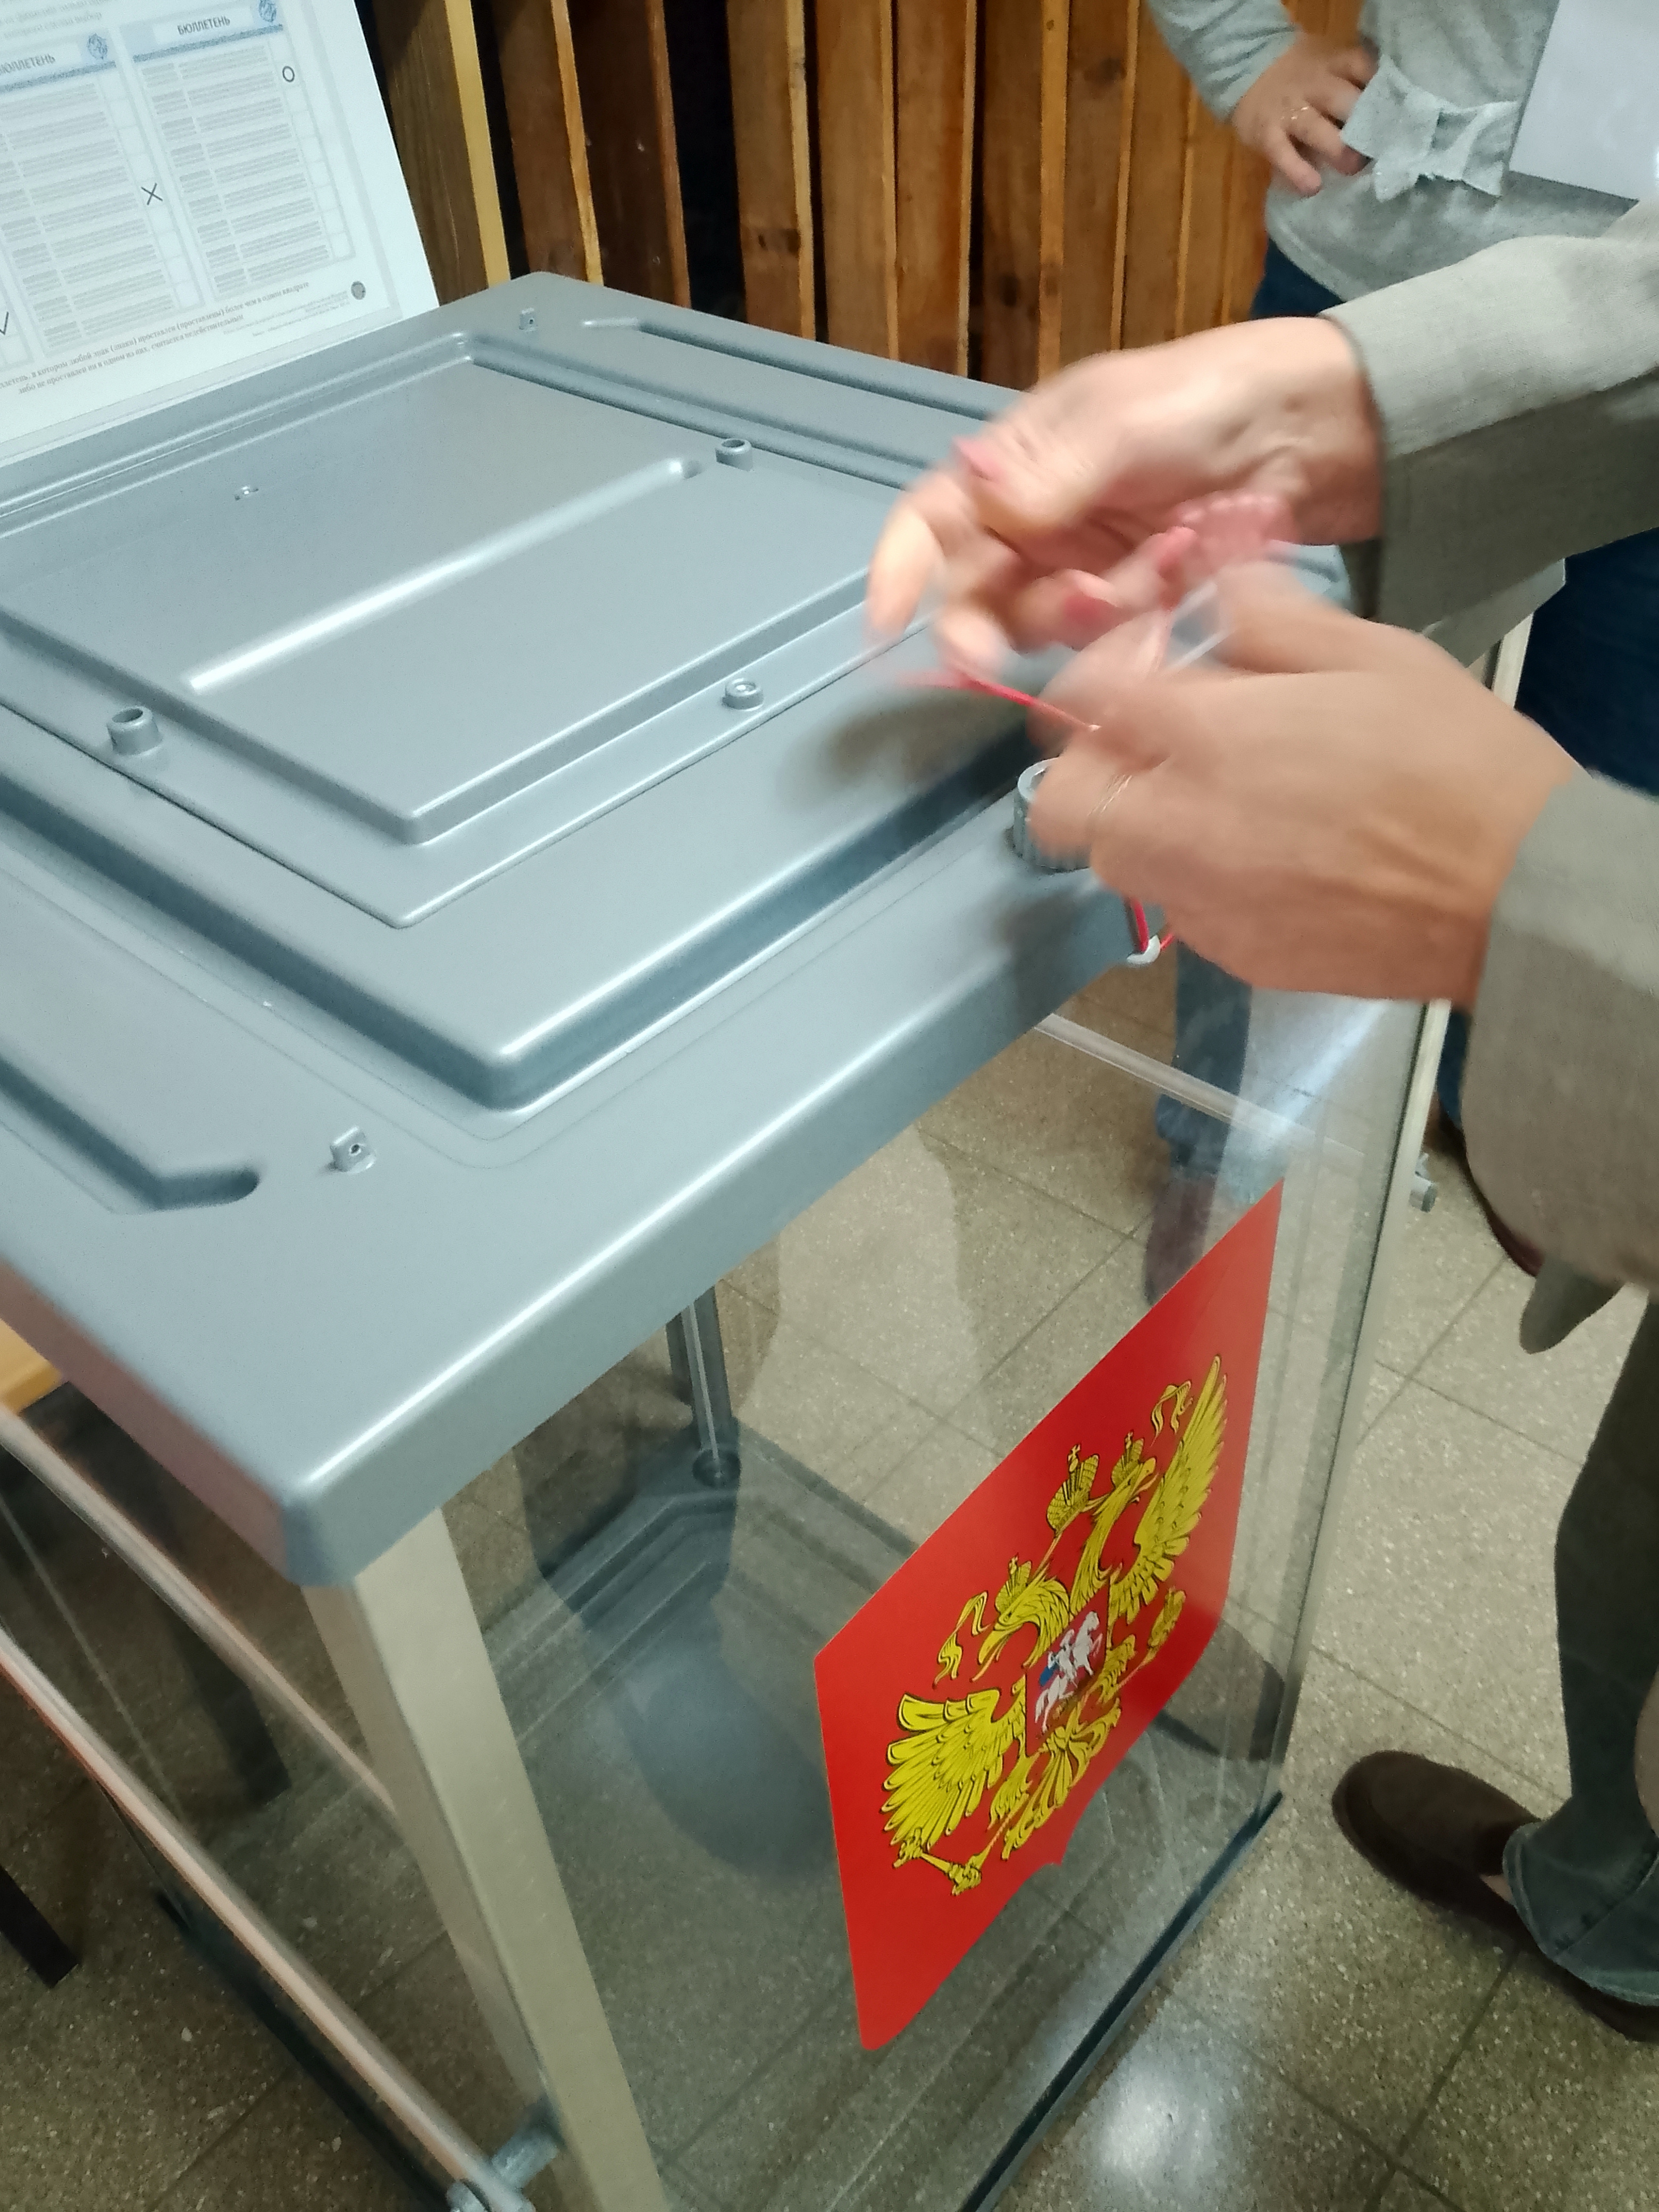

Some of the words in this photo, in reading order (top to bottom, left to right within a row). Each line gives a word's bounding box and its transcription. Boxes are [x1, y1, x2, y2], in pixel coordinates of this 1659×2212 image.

[177, 15, 230, 35] БЮЛЛЕТЕНЬ
[18, 383, 36, 394] либо
[37, 380, 45, 389] не
[46, 367, 87, 385] проставлен
[103, 355, 125, 366] одном
[151, 334, 184, 350] считается
[185, 314, 244, 338] недействительным
[37, 362, 68, 376] котором
[70, 352, 91, 365] любой
[93, 348, 110, 358] знак
[110, 337, 137, 352] (знаки)
[138, 325, 176, 343] проставлен
[177, 308, 224, 331] (проставлены)
[225, 304, 244, 314] более
[245, 298, 257, 307] чем
[282, 282, 309, 295] квадрате
